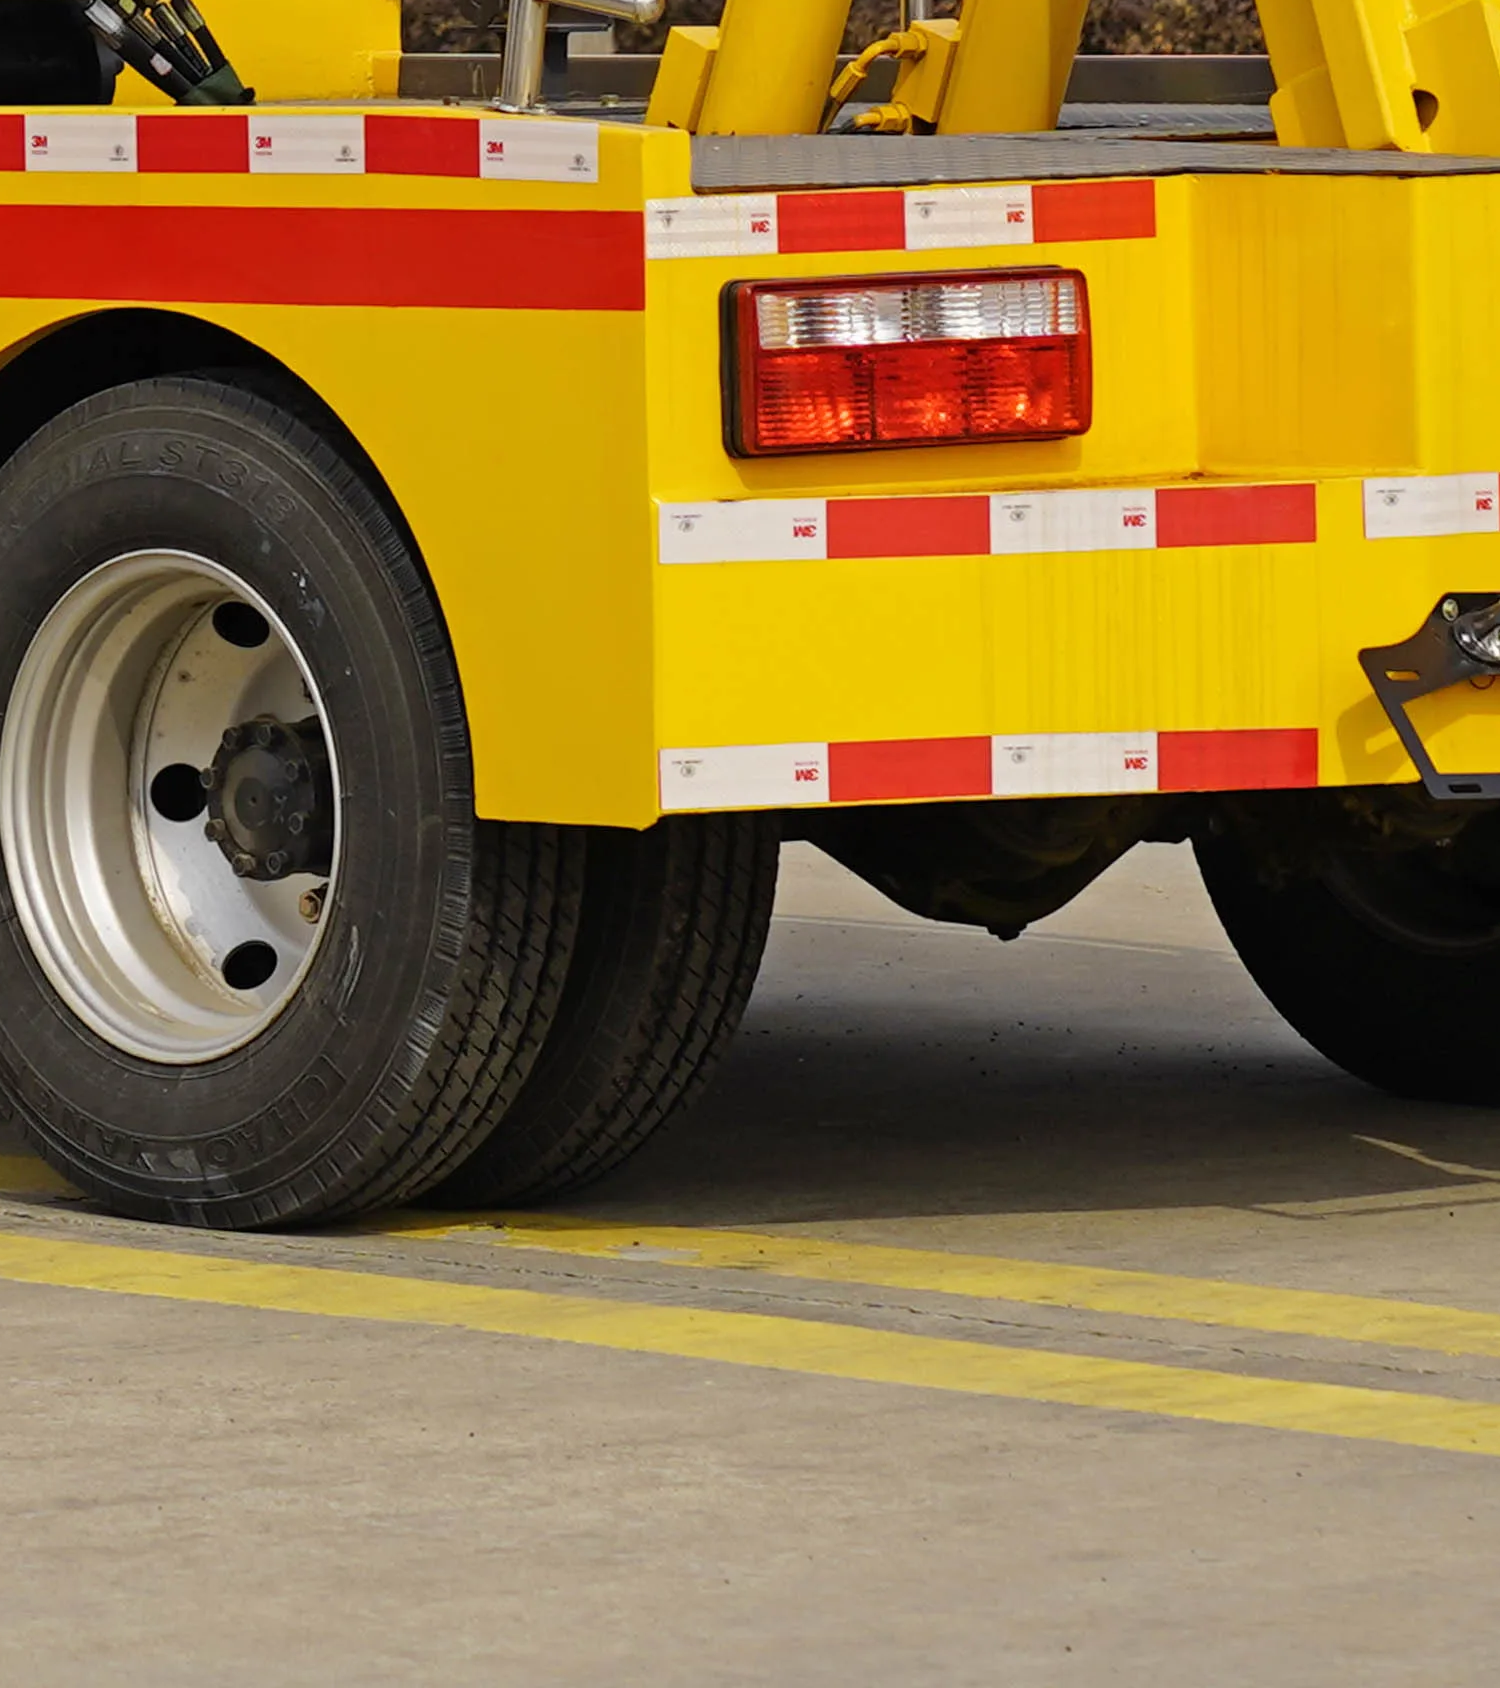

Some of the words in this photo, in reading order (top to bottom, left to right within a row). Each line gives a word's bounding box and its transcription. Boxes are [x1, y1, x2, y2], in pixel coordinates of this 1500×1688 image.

[32, 137, 47, 149] 3M
[256, 137, 272, 150] 3M
[487, 142, 504, 154] 3M
[1123, 515, 1145, 527] 3M
[794, 526, 815, 538] 3M
[1124, 758, 1147, 770] 3M
[797, 769, 818, 781] 3M
